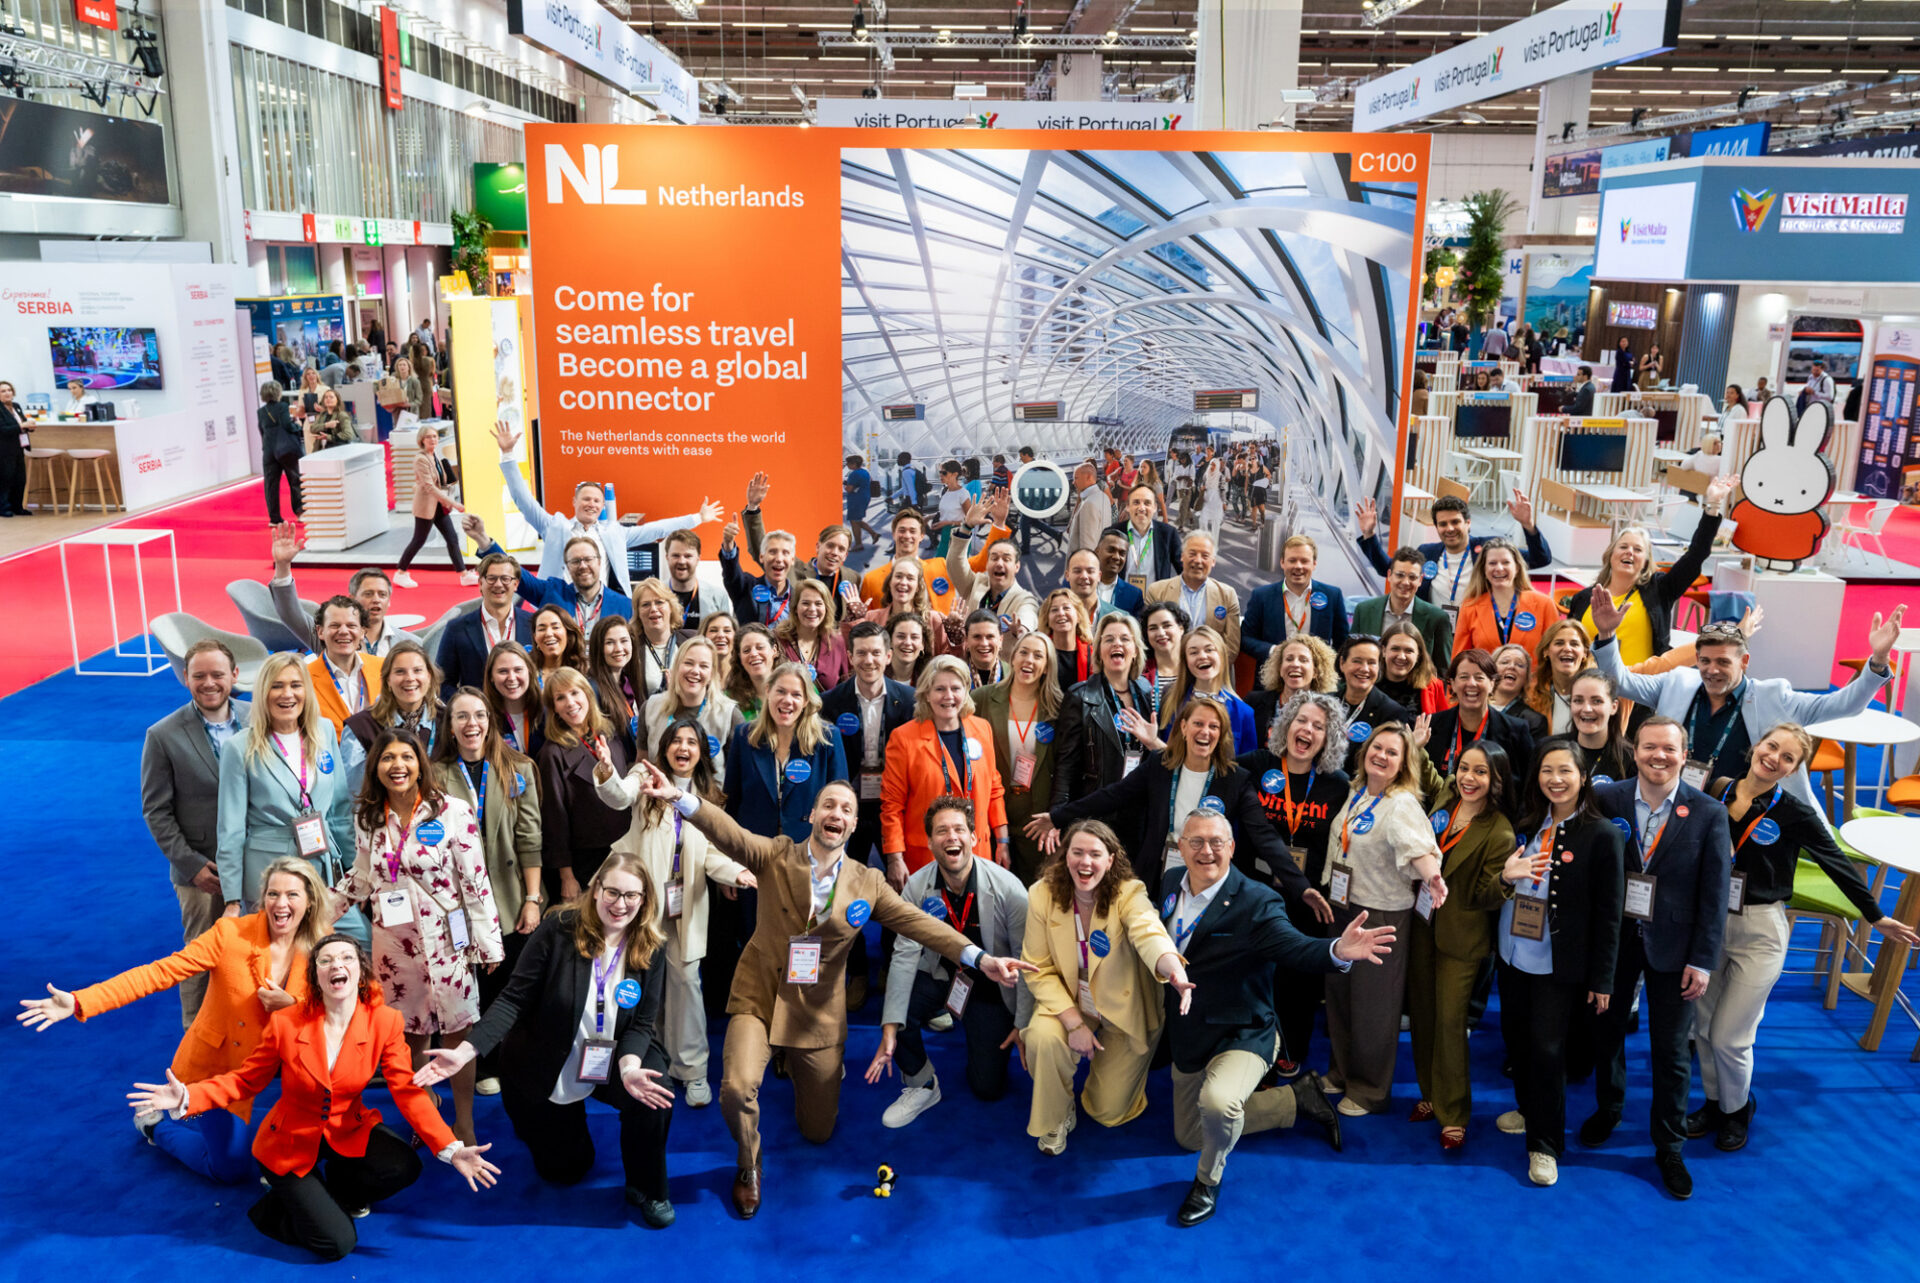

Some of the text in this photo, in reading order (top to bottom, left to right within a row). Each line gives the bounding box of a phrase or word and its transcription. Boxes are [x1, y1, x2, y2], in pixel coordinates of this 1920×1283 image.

[1523, 13, 1603, 64] visit Portugal
[1434, 60, 1491, 93] visit Portugal
[1368, 87, 1411, 115] visit Portugal
[854, 113, 892, 128] visit
[1037, 116, 1157, 130] visit Portugal
[544, 143, 647, 205] NL
[1358, 153, 1417, 173] C100
[658, 184, 804, 207] Netherlands
[1787, 193, 1905, 215] VisitMalta
[17, 301, 73, 315] SERBIA
[554, 283, 694, 312] Come for
[556, 316, 795, 346] seamless travel
[558, 351, 808, 387] Become a global
[559, 386, 715, 411] connector
[560, 430, 786, 443] The Netherlands connects the world
[561, 444, 713, 457] to your events with ease
[138, 459, 162, 474] SERBIA
